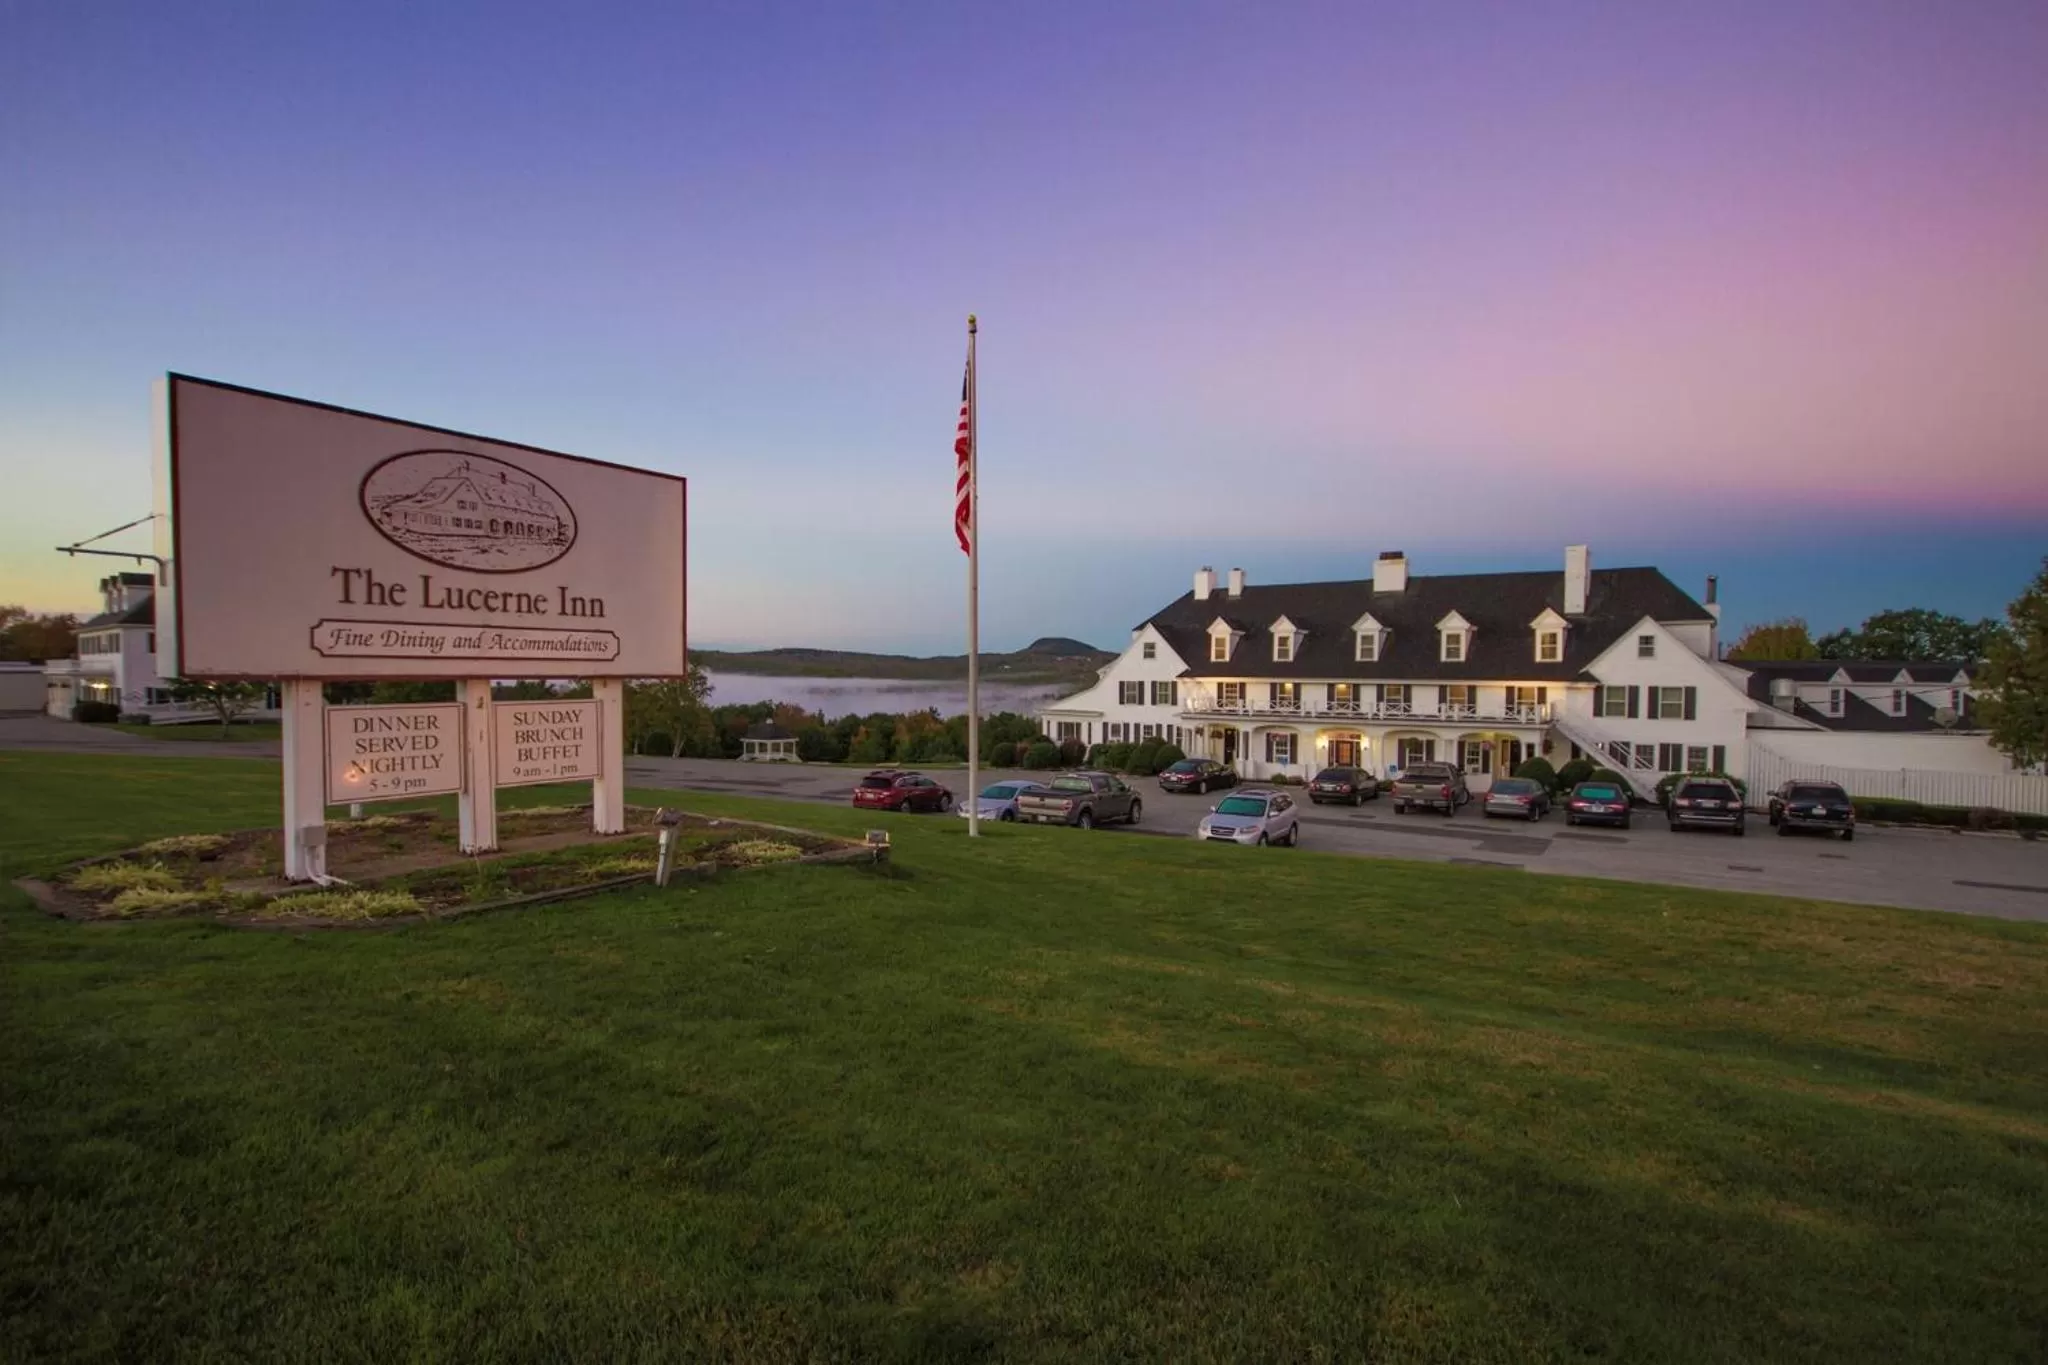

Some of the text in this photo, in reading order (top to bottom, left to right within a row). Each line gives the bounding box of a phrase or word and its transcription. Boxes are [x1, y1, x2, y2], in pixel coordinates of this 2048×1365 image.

[331, 565, 606, 618] The Lucerne Inn
[328, 628, 609, 654] Fine Dining and Accommodations
[353, 715, 441, 734] DINNER
[513, 709, 583, 726] SUNDAY
[355, 735, 440, 755] SERVED
[515, 727, 584, 744] BRUNCH
[518, 745, 582, 762] BUFFET
[351, 754, 444, 775] NIGHTLY
